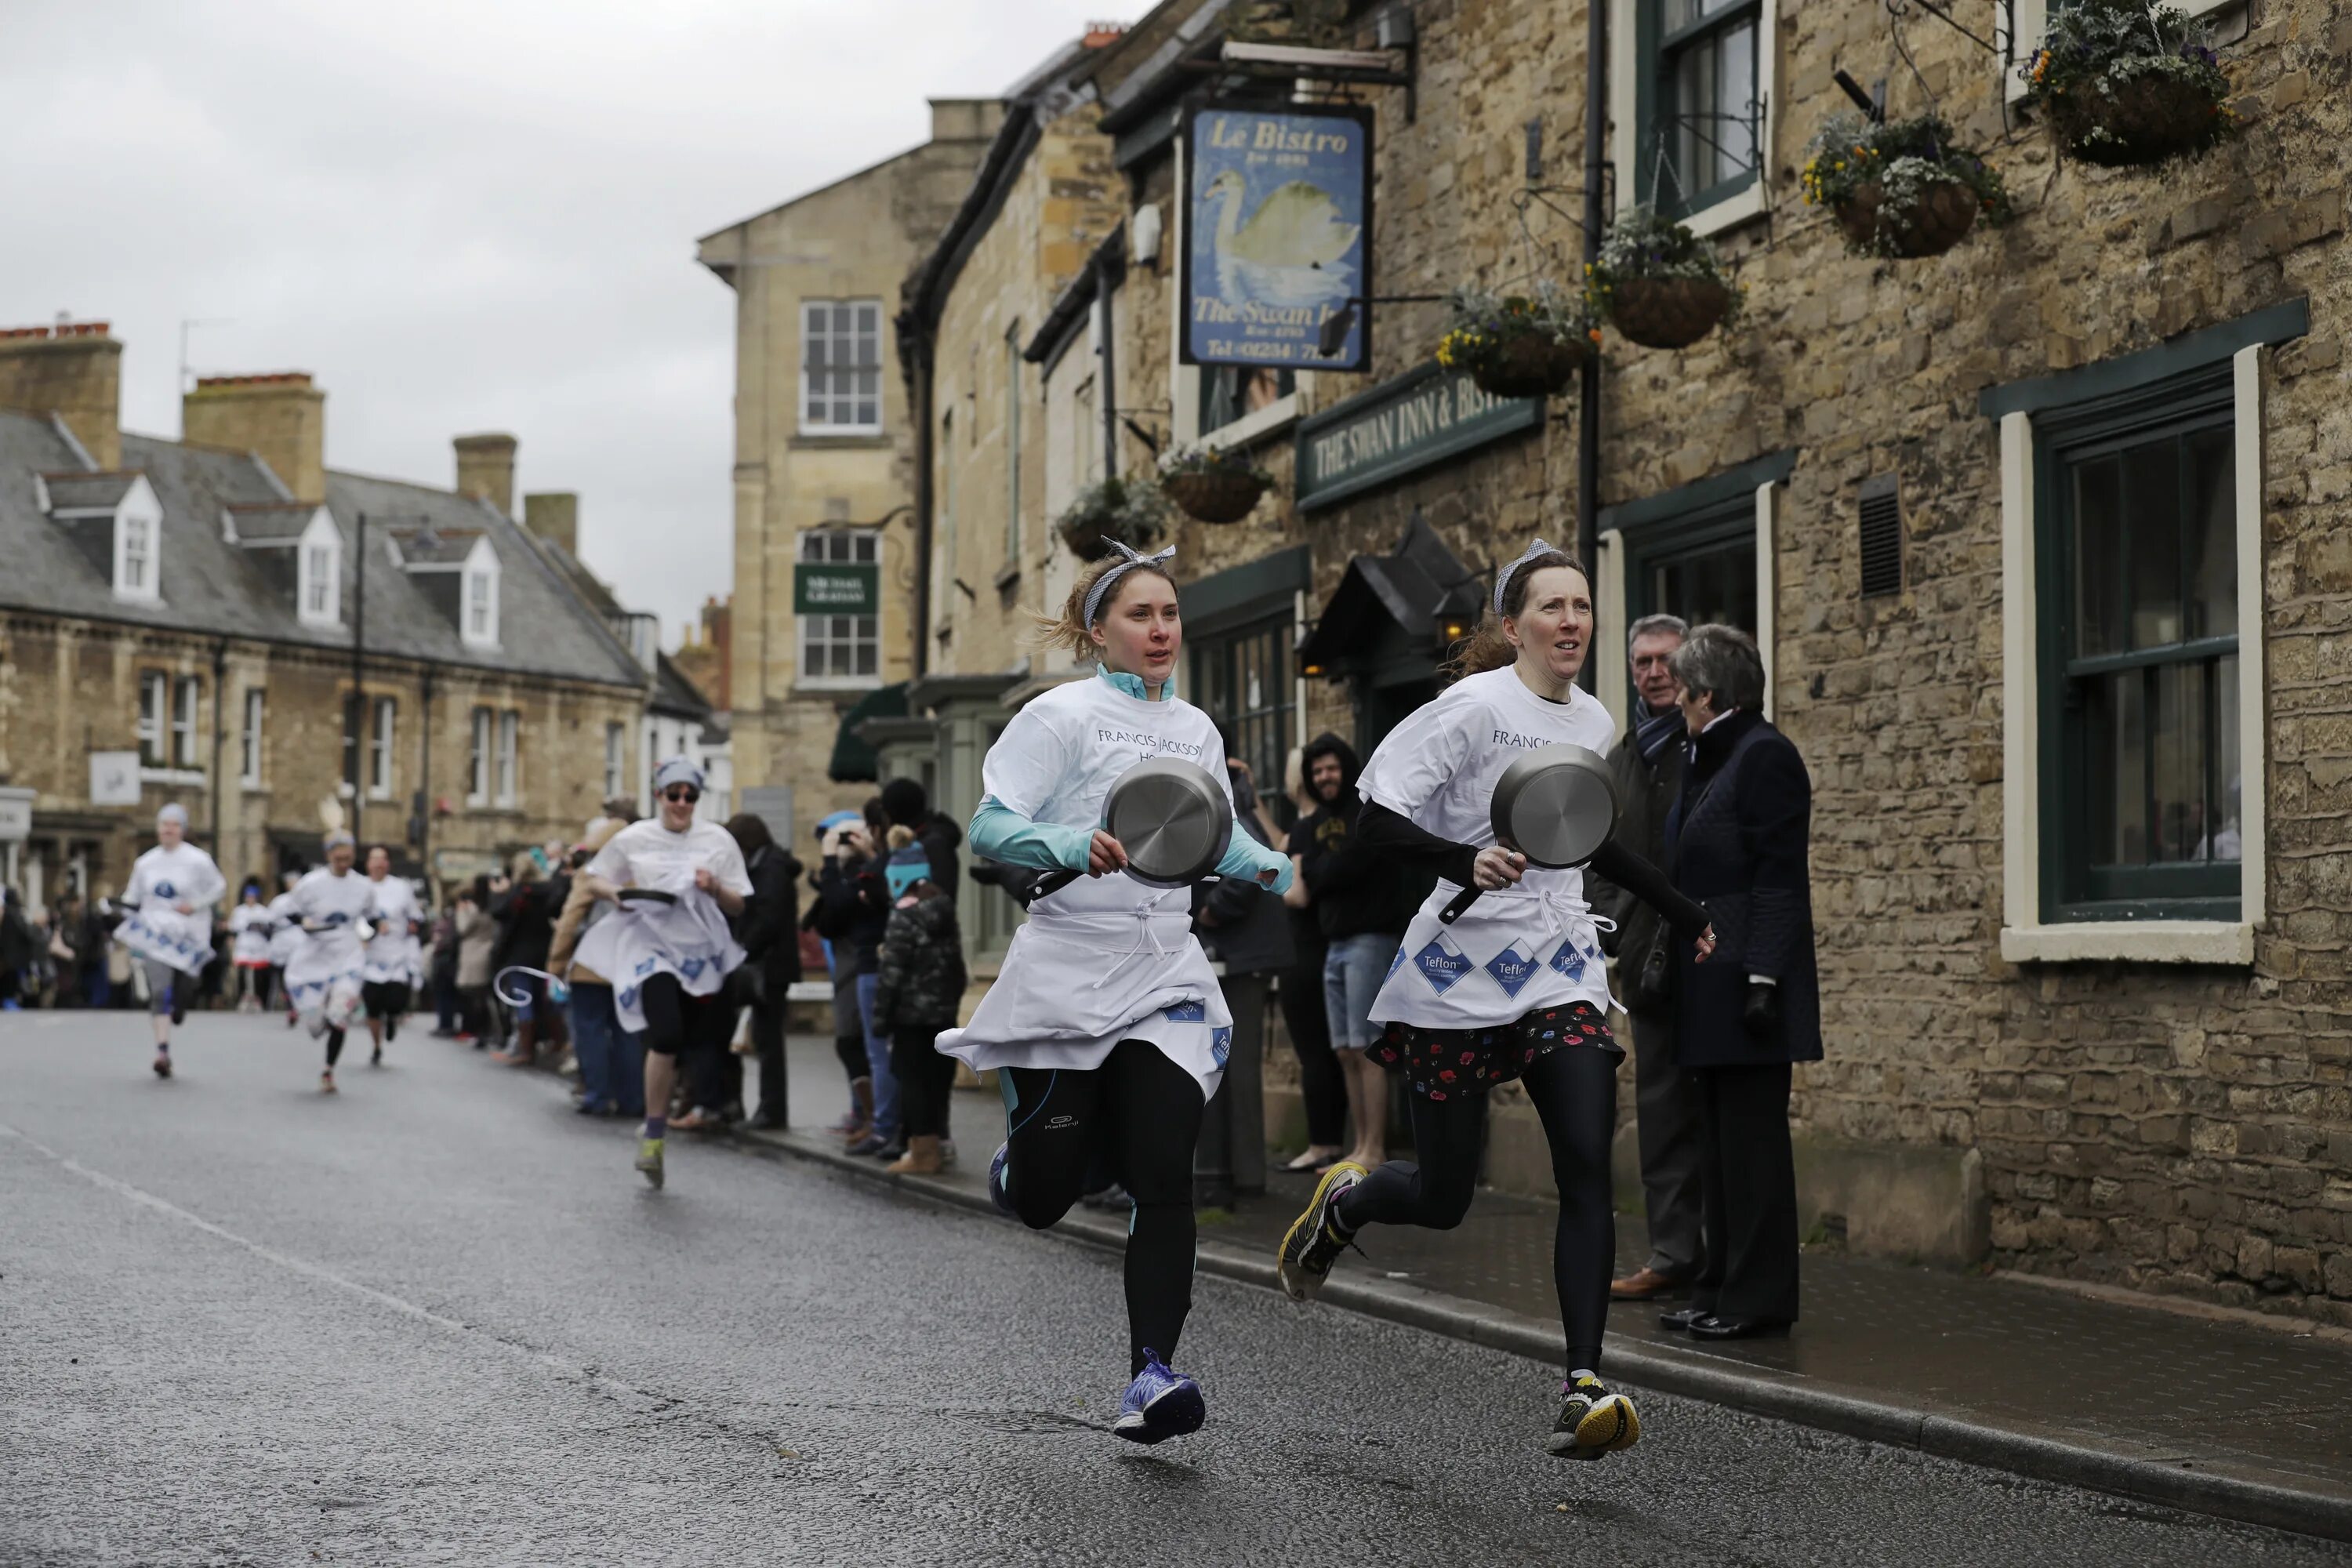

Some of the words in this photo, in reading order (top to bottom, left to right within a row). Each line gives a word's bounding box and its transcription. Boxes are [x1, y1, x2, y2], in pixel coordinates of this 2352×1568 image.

[1210, 118, 1247, 147] Le
[1254, 121, 1348, 154] Bistro
[1196, 297, 1236, 323] The
[1242, 300, 1313, 326] Swan
[1315, 429, 1348, 481] THE
[1349, 409, 1394, 467] SWAN
[1398, 391, 1435, 445] INN
[1438, 385, 1452, 429] &
[1098, 729, 1156, 747] FRANCIS
